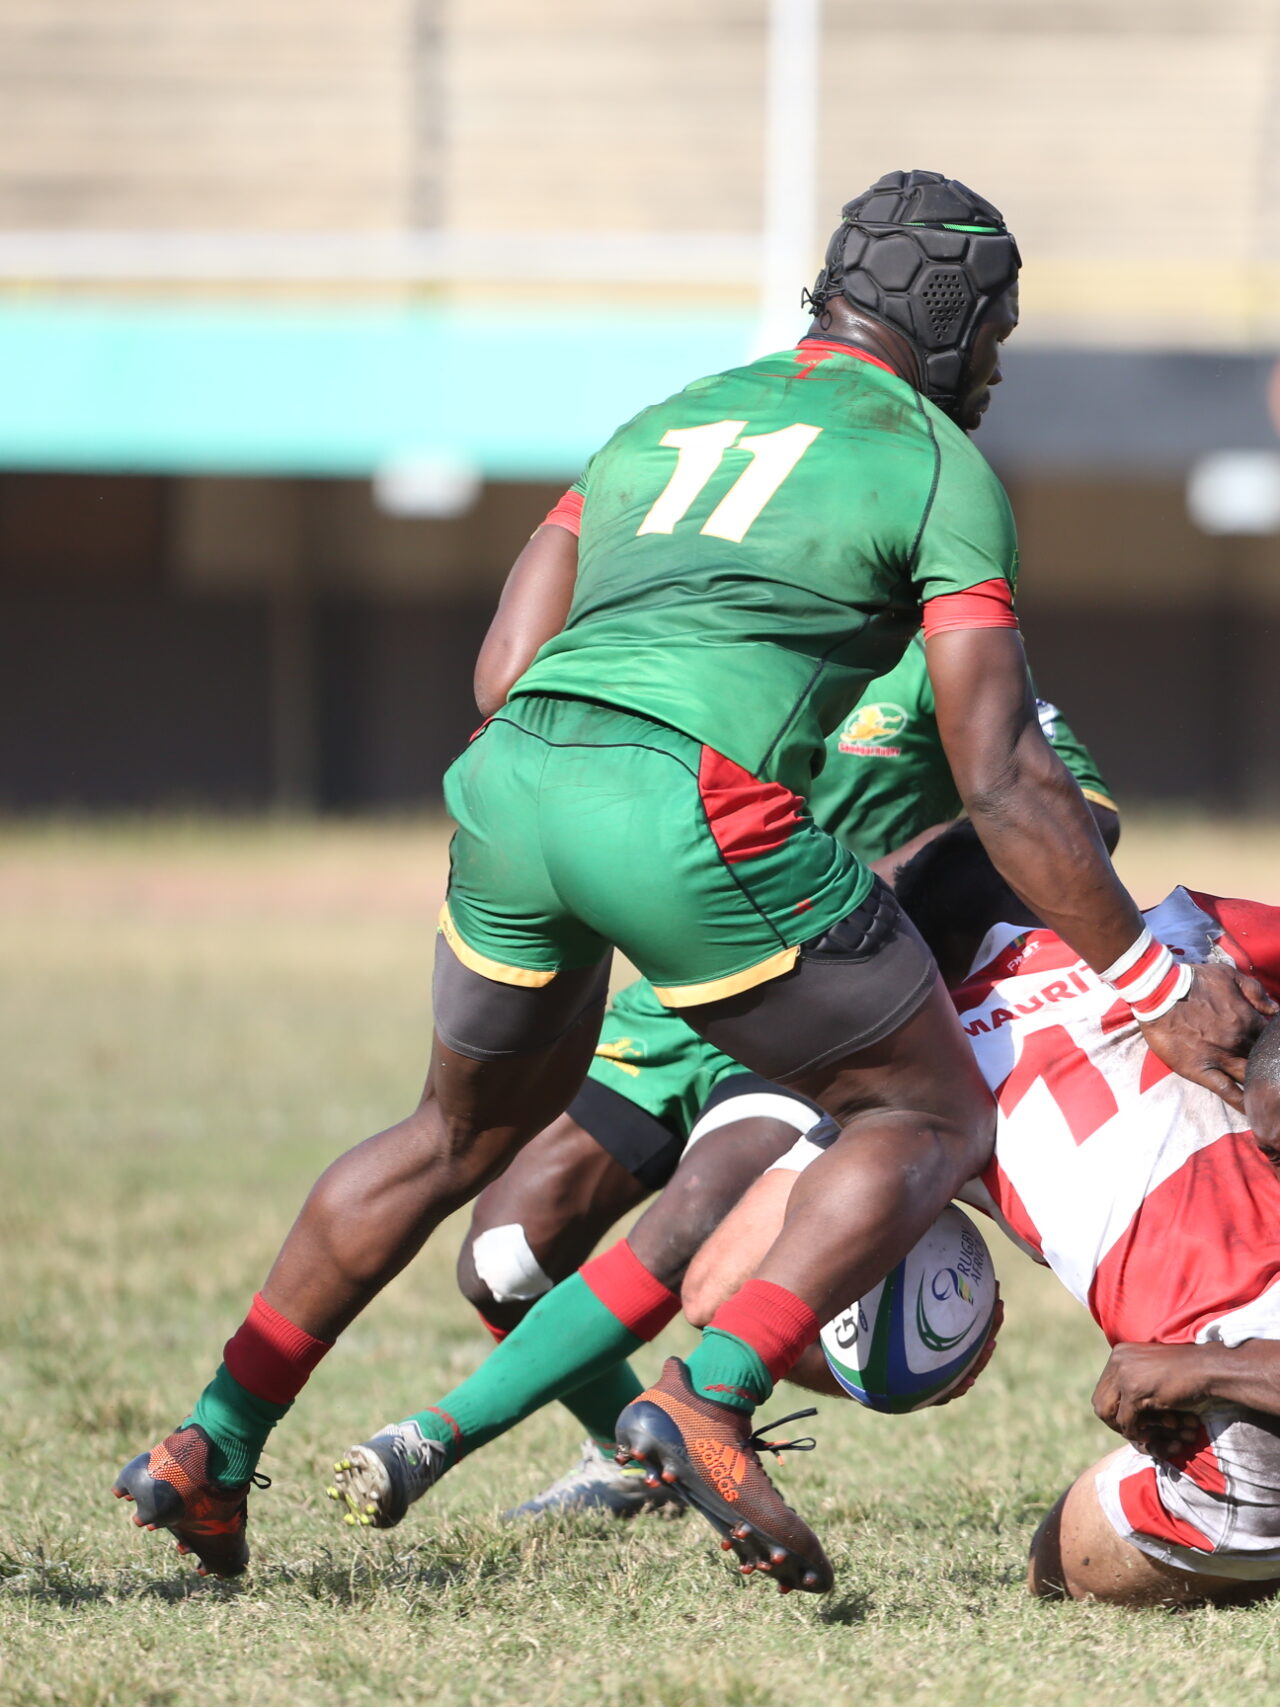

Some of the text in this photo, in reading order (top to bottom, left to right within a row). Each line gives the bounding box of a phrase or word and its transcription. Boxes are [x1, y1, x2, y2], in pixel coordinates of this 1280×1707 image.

[636, 419, 825, 543] 11
[957, 1225, 975, 1277] RUGBY
[695, 1440, 738, 1502] adidas
